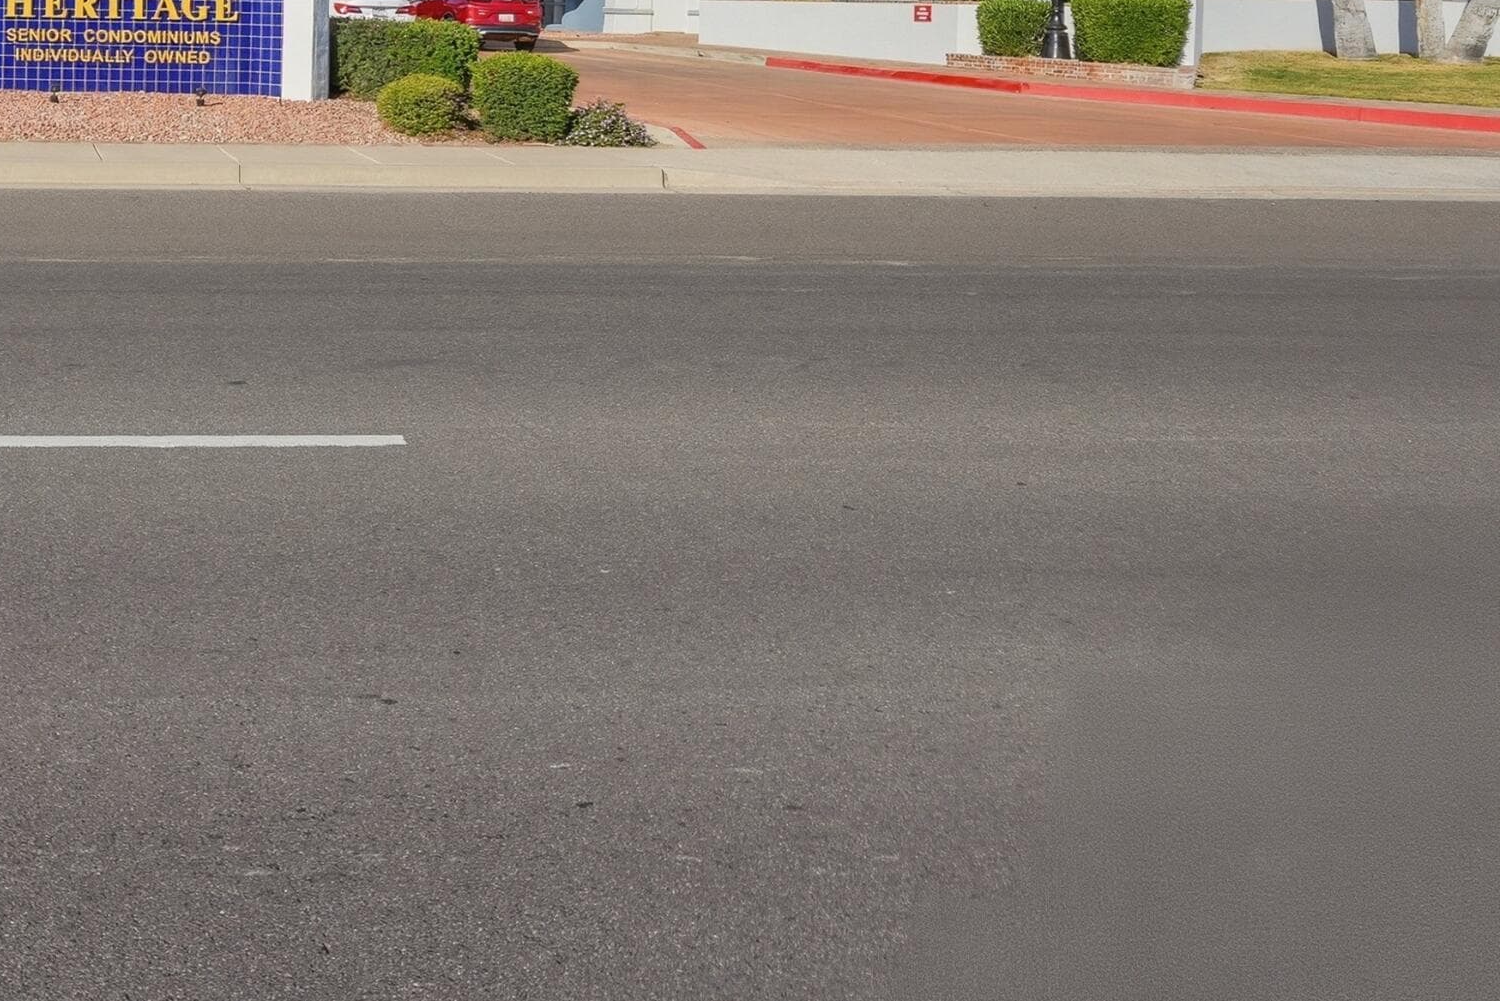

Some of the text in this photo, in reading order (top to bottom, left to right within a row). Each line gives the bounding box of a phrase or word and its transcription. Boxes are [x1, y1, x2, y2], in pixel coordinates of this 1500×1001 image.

[6, 28, 221, 45] SENIOR CONDOMINIUMS
[15, 48, 210, 64] INDIVIDUALLY OWNED
